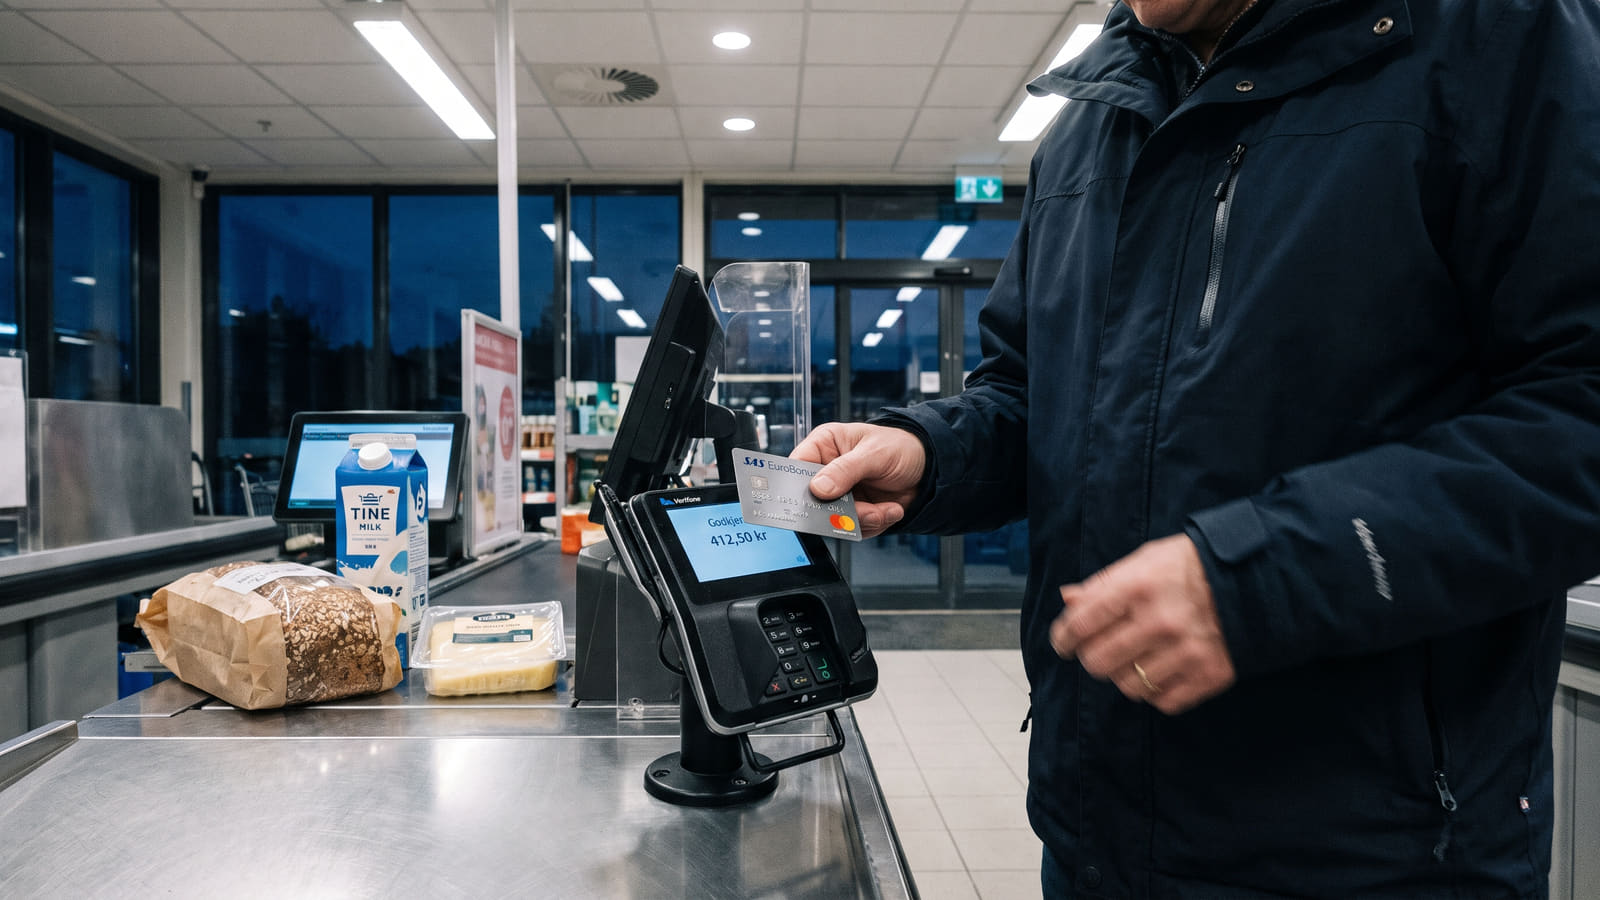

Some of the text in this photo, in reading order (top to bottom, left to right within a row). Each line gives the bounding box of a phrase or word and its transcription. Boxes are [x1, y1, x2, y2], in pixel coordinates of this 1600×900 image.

[744, 456, 765, 468] SAS
[350, 507, 390, 520] TINE
[359, 523, 382, 531] MILK
[710, 530, 767, 547] 412,50 kr
[770, 631, 777, 639] 5
[803, 641, 810, 649] 9
[777, 646, 785, 654] 8
